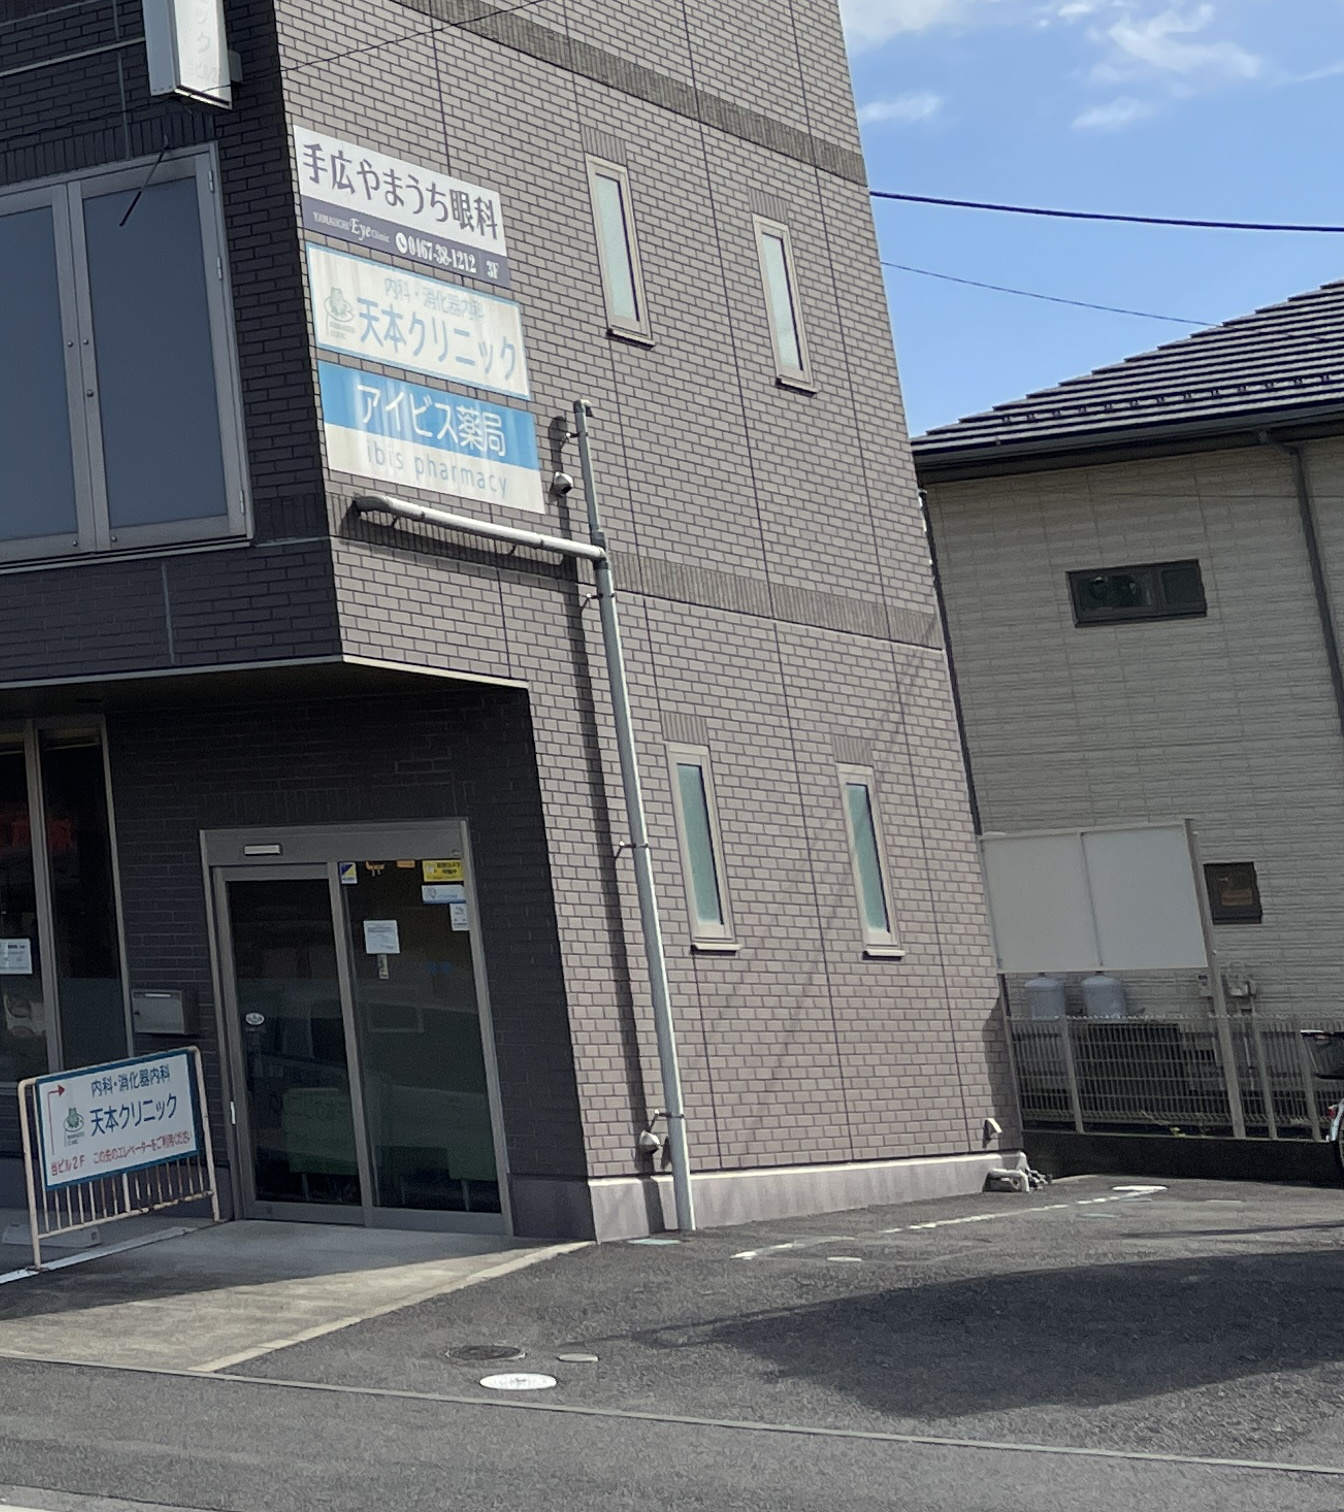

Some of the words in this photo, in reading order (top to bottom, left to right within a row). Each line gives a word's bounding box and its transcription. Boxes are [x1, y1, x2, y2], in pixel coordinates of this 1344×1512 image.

[302, 142, 498, 240] 手広やまうち眼科
[349, 218, 372, 242] Eye
[356, 296, 518, 379] 天本クリニック
[356, 384, 507, 457] アイビス薬局
[366, 439, 404, 470] ibis
[414, 452, 508, 499] pharmacy
[91, 1063, 171, 1098] 内科・消化器内科
[89, 1092, 178, 1137] 天本クリニック
